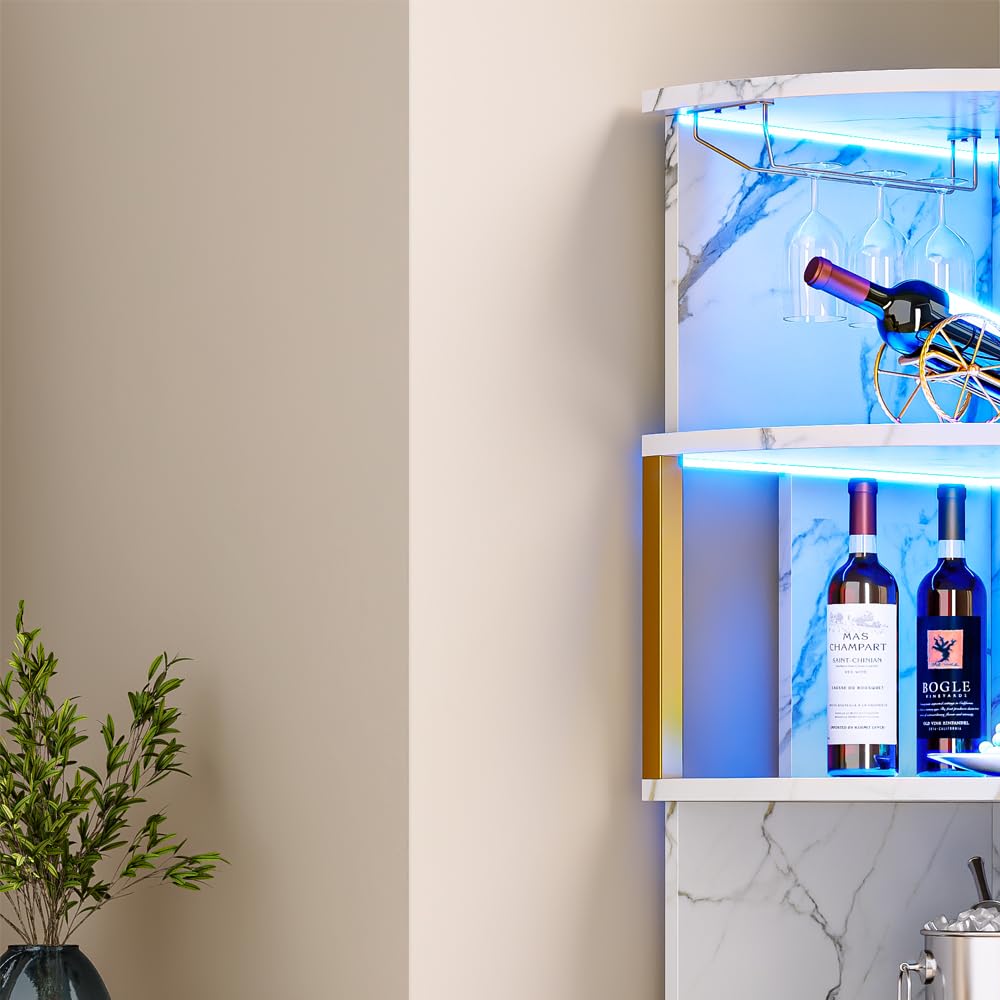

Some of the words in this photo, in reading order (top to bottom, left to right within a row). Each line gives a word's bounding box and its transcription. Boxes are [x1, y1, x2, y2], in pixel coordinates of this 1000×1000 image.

[842, 632, 869, 641] MAS
[829, 643, 887, 651] CHAMPART
[922, 681, 971, 693] BOGLE
